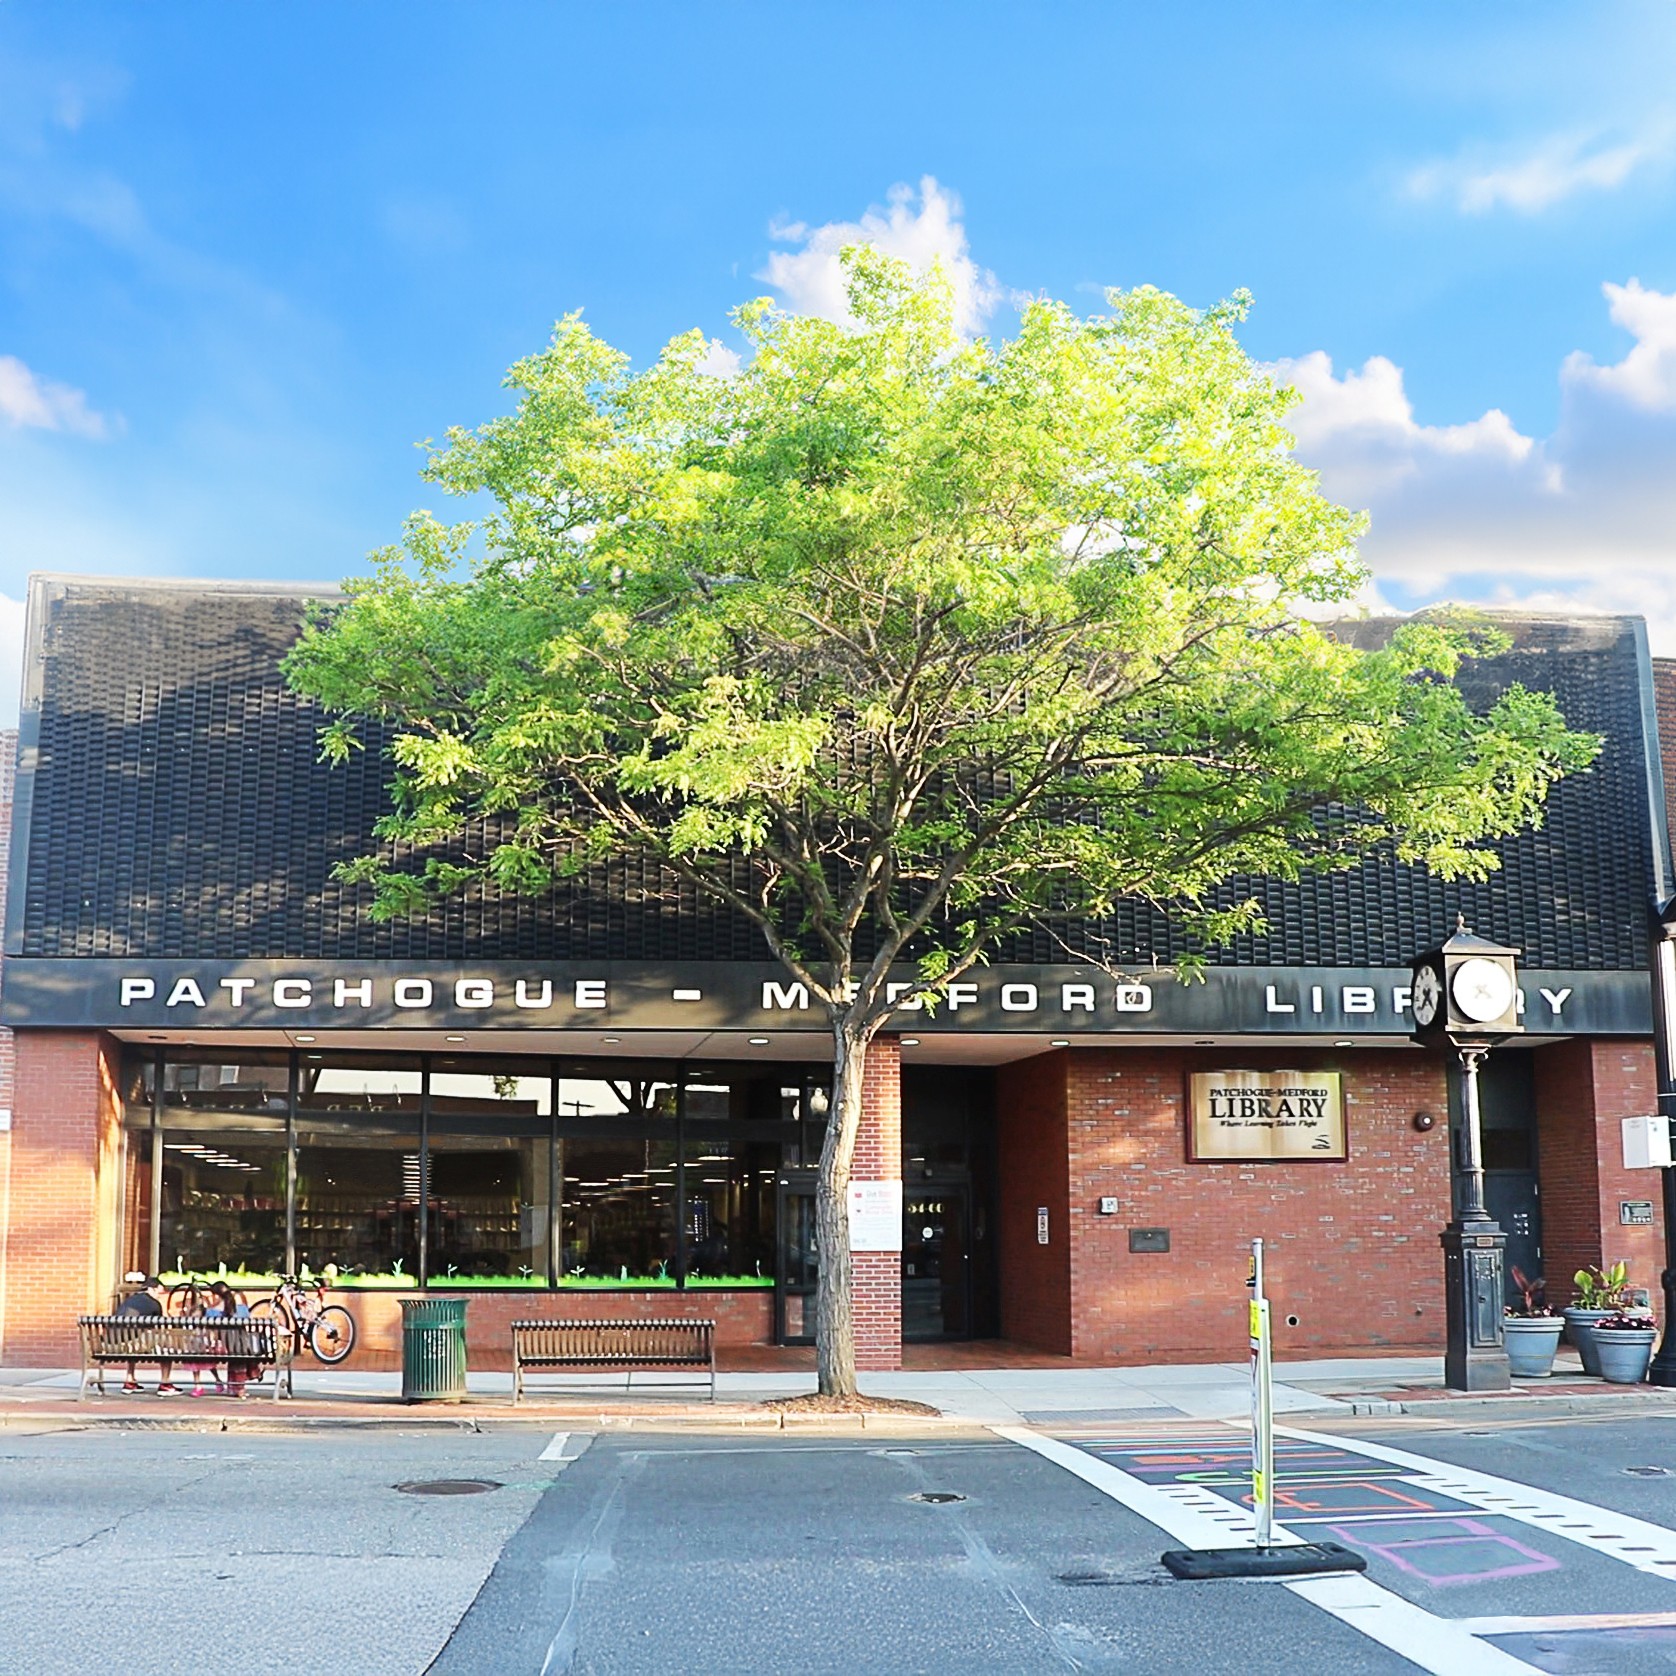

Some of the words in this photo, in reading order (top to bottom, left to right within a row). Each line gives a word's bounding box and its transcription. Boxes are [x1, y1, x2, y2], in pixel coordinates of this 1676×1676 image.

[119, 978, 608, 1009] PATCHOGUE
[761, 980, 1153, 1012] MDFORD
[1209, 1088, 1328, 1097] PATCHOGUE-MEDFORD
[1208, 1097, 1328, 1118] LIBRARY
